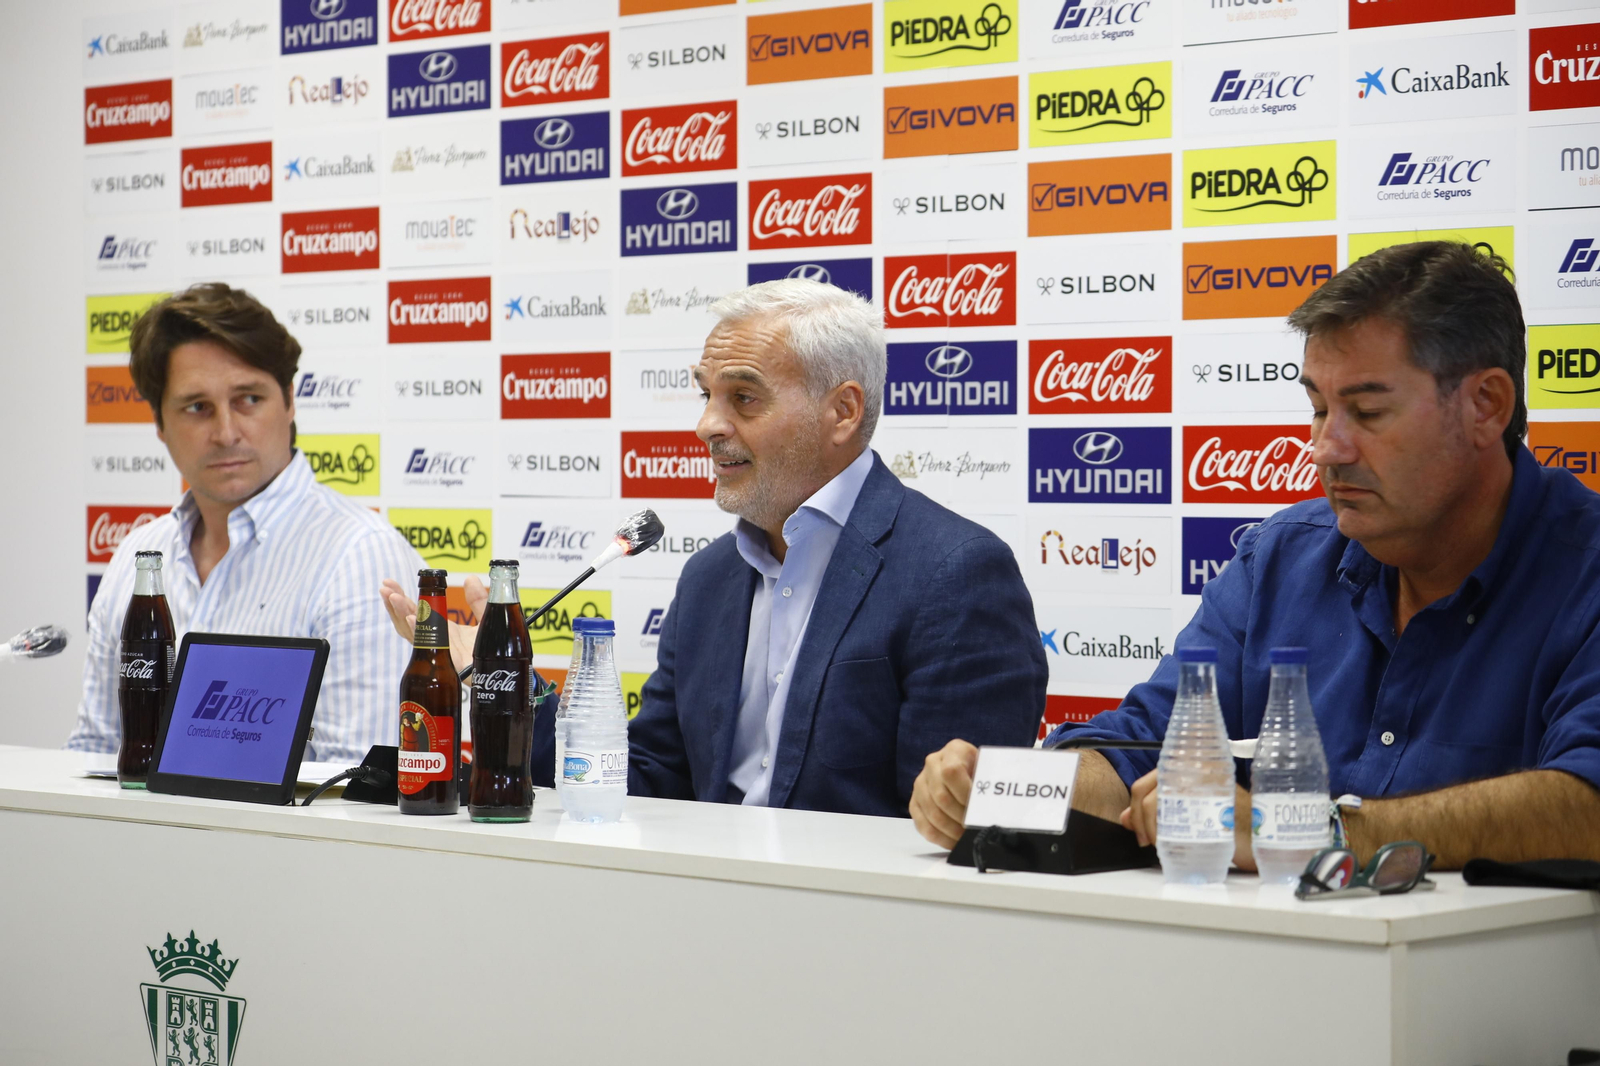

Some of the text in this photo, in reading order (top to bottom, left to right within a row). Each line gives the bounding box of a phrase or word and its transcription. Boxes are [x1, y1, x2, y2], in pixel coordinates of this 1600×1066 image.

[1083, 1, 1150, 28] PACC
[105, 30, 169, 56] CaixaBank
[285, 16, 373, 48] HYUNDAI
[771, 29, 869, 57] GIVOVA
[1101, 28, 1134, 42] Seguros
[647, 44, 726, 68] SILBON
[504, 42, 606, 98] Coca-Cola
[1391, 61, 1510, 94] CaixaBank
[391, 79, 486, 111] HYUNDAI
[1242, 74, 1315, 100] PACC
[86, 99, 170, 128] Cruzcampo
[909, 102, 1015, 130] GIVOVA
[1250, 103, 1260, 114] de
[1261, 102, 1297, 115] Seguros
[625, 111, 733, 167] Coca-Cola
[777, 115, 860, 138] SILBON
[304, 154, 375, 179] CaixaBank
[505, 148, 604, 178] HYUNDAI
[1413, 159, 1491, 185] PACC
[1426, 155, 1454, 163] GRUPO
[106, 172, 165, 192] SILBON
[182, 162, 270, 190] Cruzcampo
[915, 193, 1005, 214] SILBON
[1055, 181, 1167, 208] GIVOVA
[1421, 188, 1431, 199] de
[1433, 188, 1471, 201] Seguros
[753, 184, 866, 240] Coca-Cola
[202, 238, 265, 257] SILBON
[282, 228, 378, 257] Cruzcampo
[626, 220, 731, 249] HYUNDAI
[889, 263, 1009, 317] Coca-Cola
[1061, 273, 1155, 295] SILBON
[1212, 264, 1332, 290] GIVOVA
[304, 307, 370, 325] SILBON
[389, 297, 488, 328] Cruzcampo
[527, 295, 607, 319] CaixaBank
[1034, 348, 1162, 403] Coca-Cola
[1218, 362, 1300, 383] SILBO
[1538, 348, 1600, 379] PiED
[102, 385, 145, 404] GIVO
[412, 379, 482, 397] SILBON
[503, 371, 608, 404] Cruzcampo
[890, 380, 1009, 406] HYUNDAI
[106, 455, 165, 473] SILBON
[428, 455, 475, 475] PACC
[527, 454, 601, 472] SILBON
[623, 449, 718, 483] Cruzcamp
[1188, 436, 1319, 492] Coca-Cola
[1036, 469, 1163, 494] HYUNDAI
[545, 530, 595, 549] PACC
[1063, 631, 1165, 660] CaixaBank
[235, 688, 259, 697] GRUPO
[477, 692, 496, 700] zero
[218, 695, 287, 725] PACC
[220, 728, 231, 740] de
[230, 728, 262, 744] Seguros
[399, 758, 441, 771] zcampo
[993, 781, 1068, 800] SILBON
